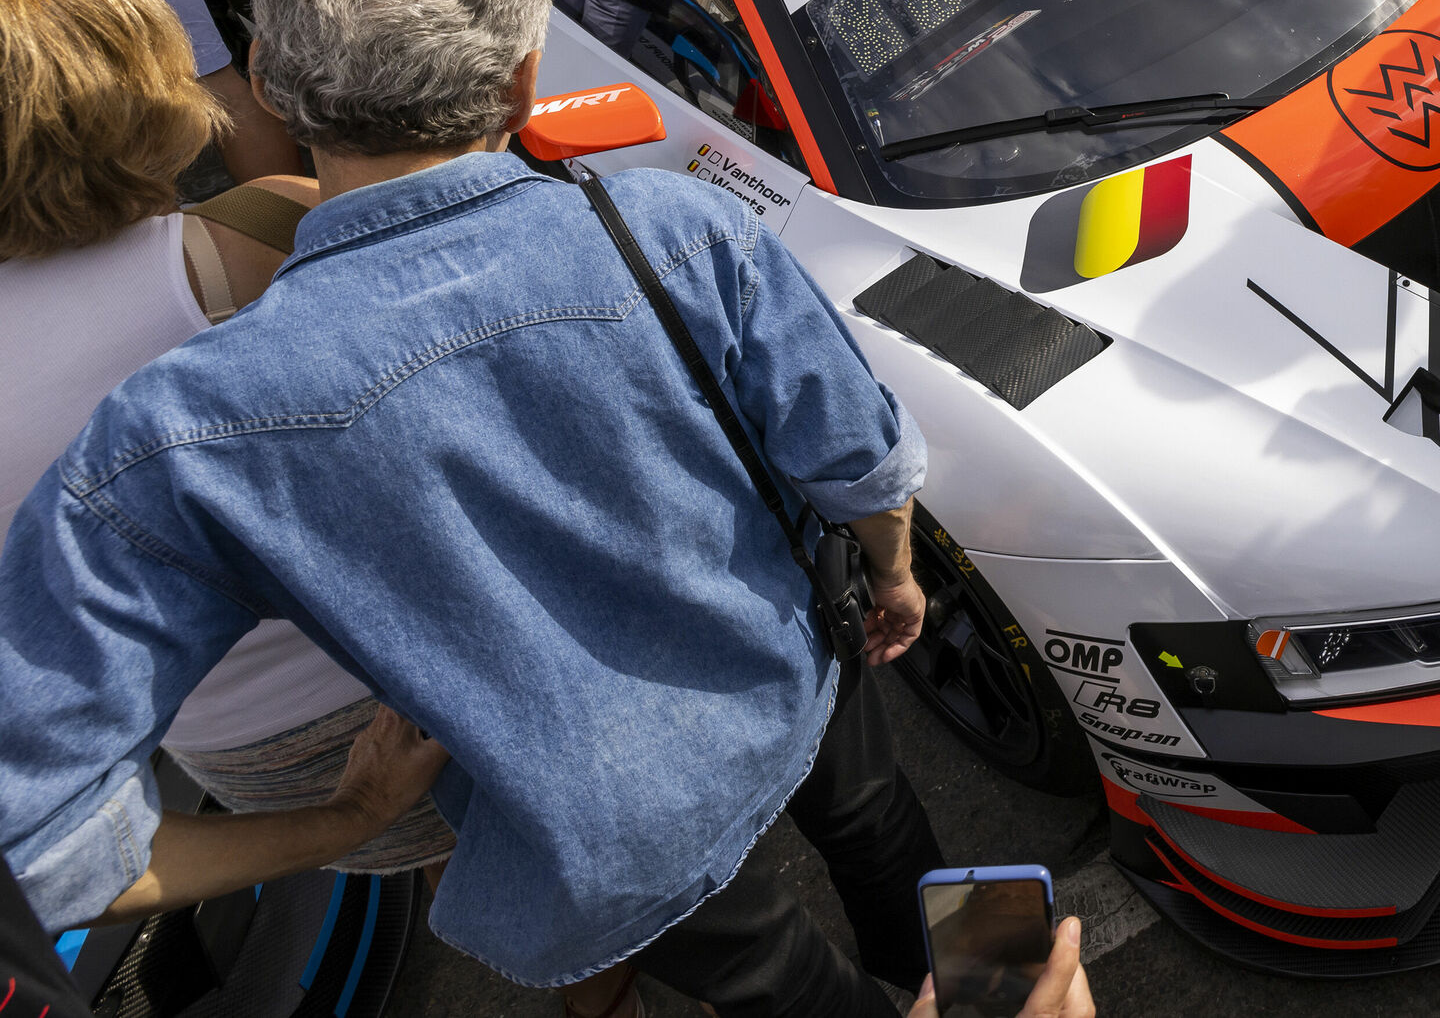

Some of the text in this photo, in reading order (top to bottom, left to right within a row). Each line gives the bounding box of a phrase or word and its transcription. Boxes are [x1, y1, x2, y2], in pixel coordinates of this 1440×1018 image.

[530, 87, 632, 117] WRT
[1003, 624, 1028, 649] FR
[1044, 638, 1124, 674] OMP
[1093, 691, 1161, 719] R8
[1078, 712, 1182, 747] Snap-on
[1110, 759, 1217, 794] GrafiWrap
